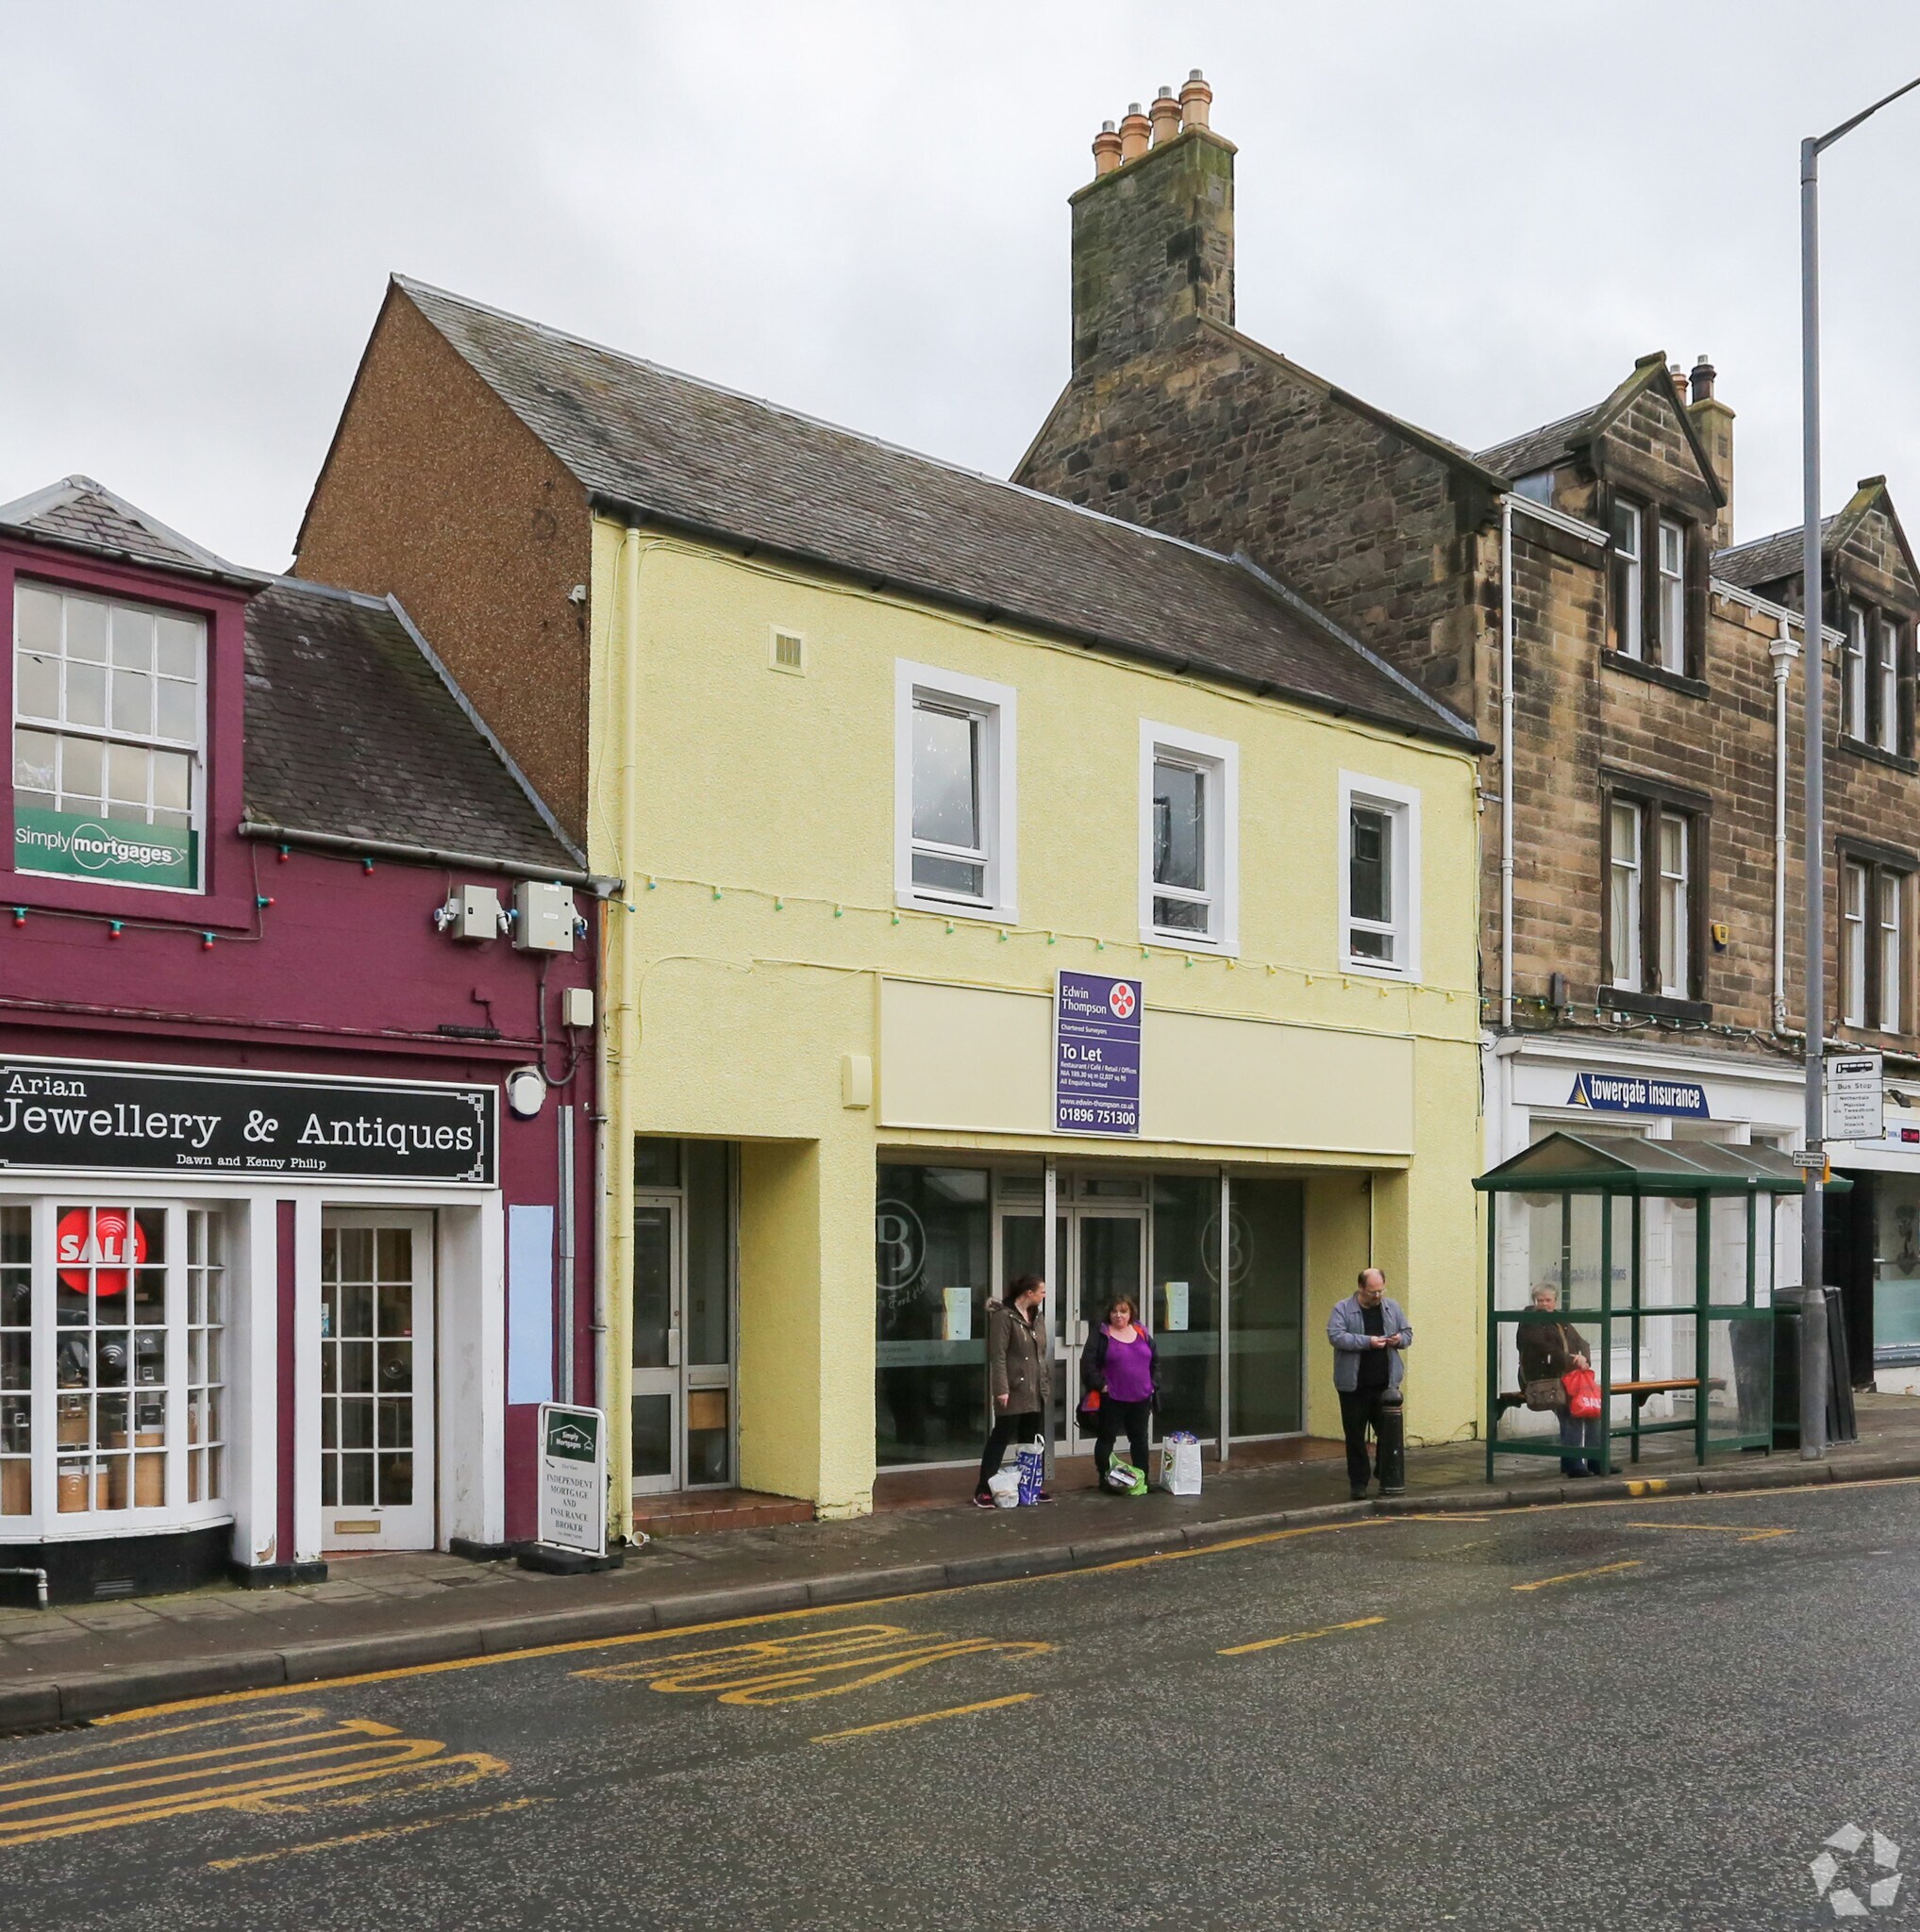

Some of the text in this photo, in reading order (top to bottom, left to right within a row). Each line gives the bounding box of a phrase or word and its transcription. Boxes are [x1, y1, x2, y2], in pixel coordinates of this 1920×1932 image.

[74, 838, 173, 864] mortgages
[1062, 985, 1089, 999] Edwin
[1061, 998, 1107, 1016] Thompson
[1060, 1024, 1108, 1035] Chartered Surveyors
[1060, 1043, 1102, 1062] To Let
[1060, 1061, 1088, 1070] Restaurant
[6, 1074, 87, 1097] Arian
[1068, 1078, 1091, 1088] Enquiries
[1591, 1074, 1700, 1108] towergate insurance
[1060, 1107, 1136, 1124] 01896 751300
[0, 1097, 474, 1155] Jewellery & Antiques
[176, 1153, 326, 1171] Dawn and Kenny Philip
[59, 1234, 139, 1262] SALE
[555, 1438, 581, 1450] Mortgages
[561, 1431, 579, 1441] Simply
[546, 1473, 593, 1490] INDEPENDENT
[550, 1485, 589, 1500] MORTGAGE
[562, 1499, 576, 1508] AND
[550, 1507, 589, 1523] INSURANCE
[555, 1520, 583, 1533] BROKER
